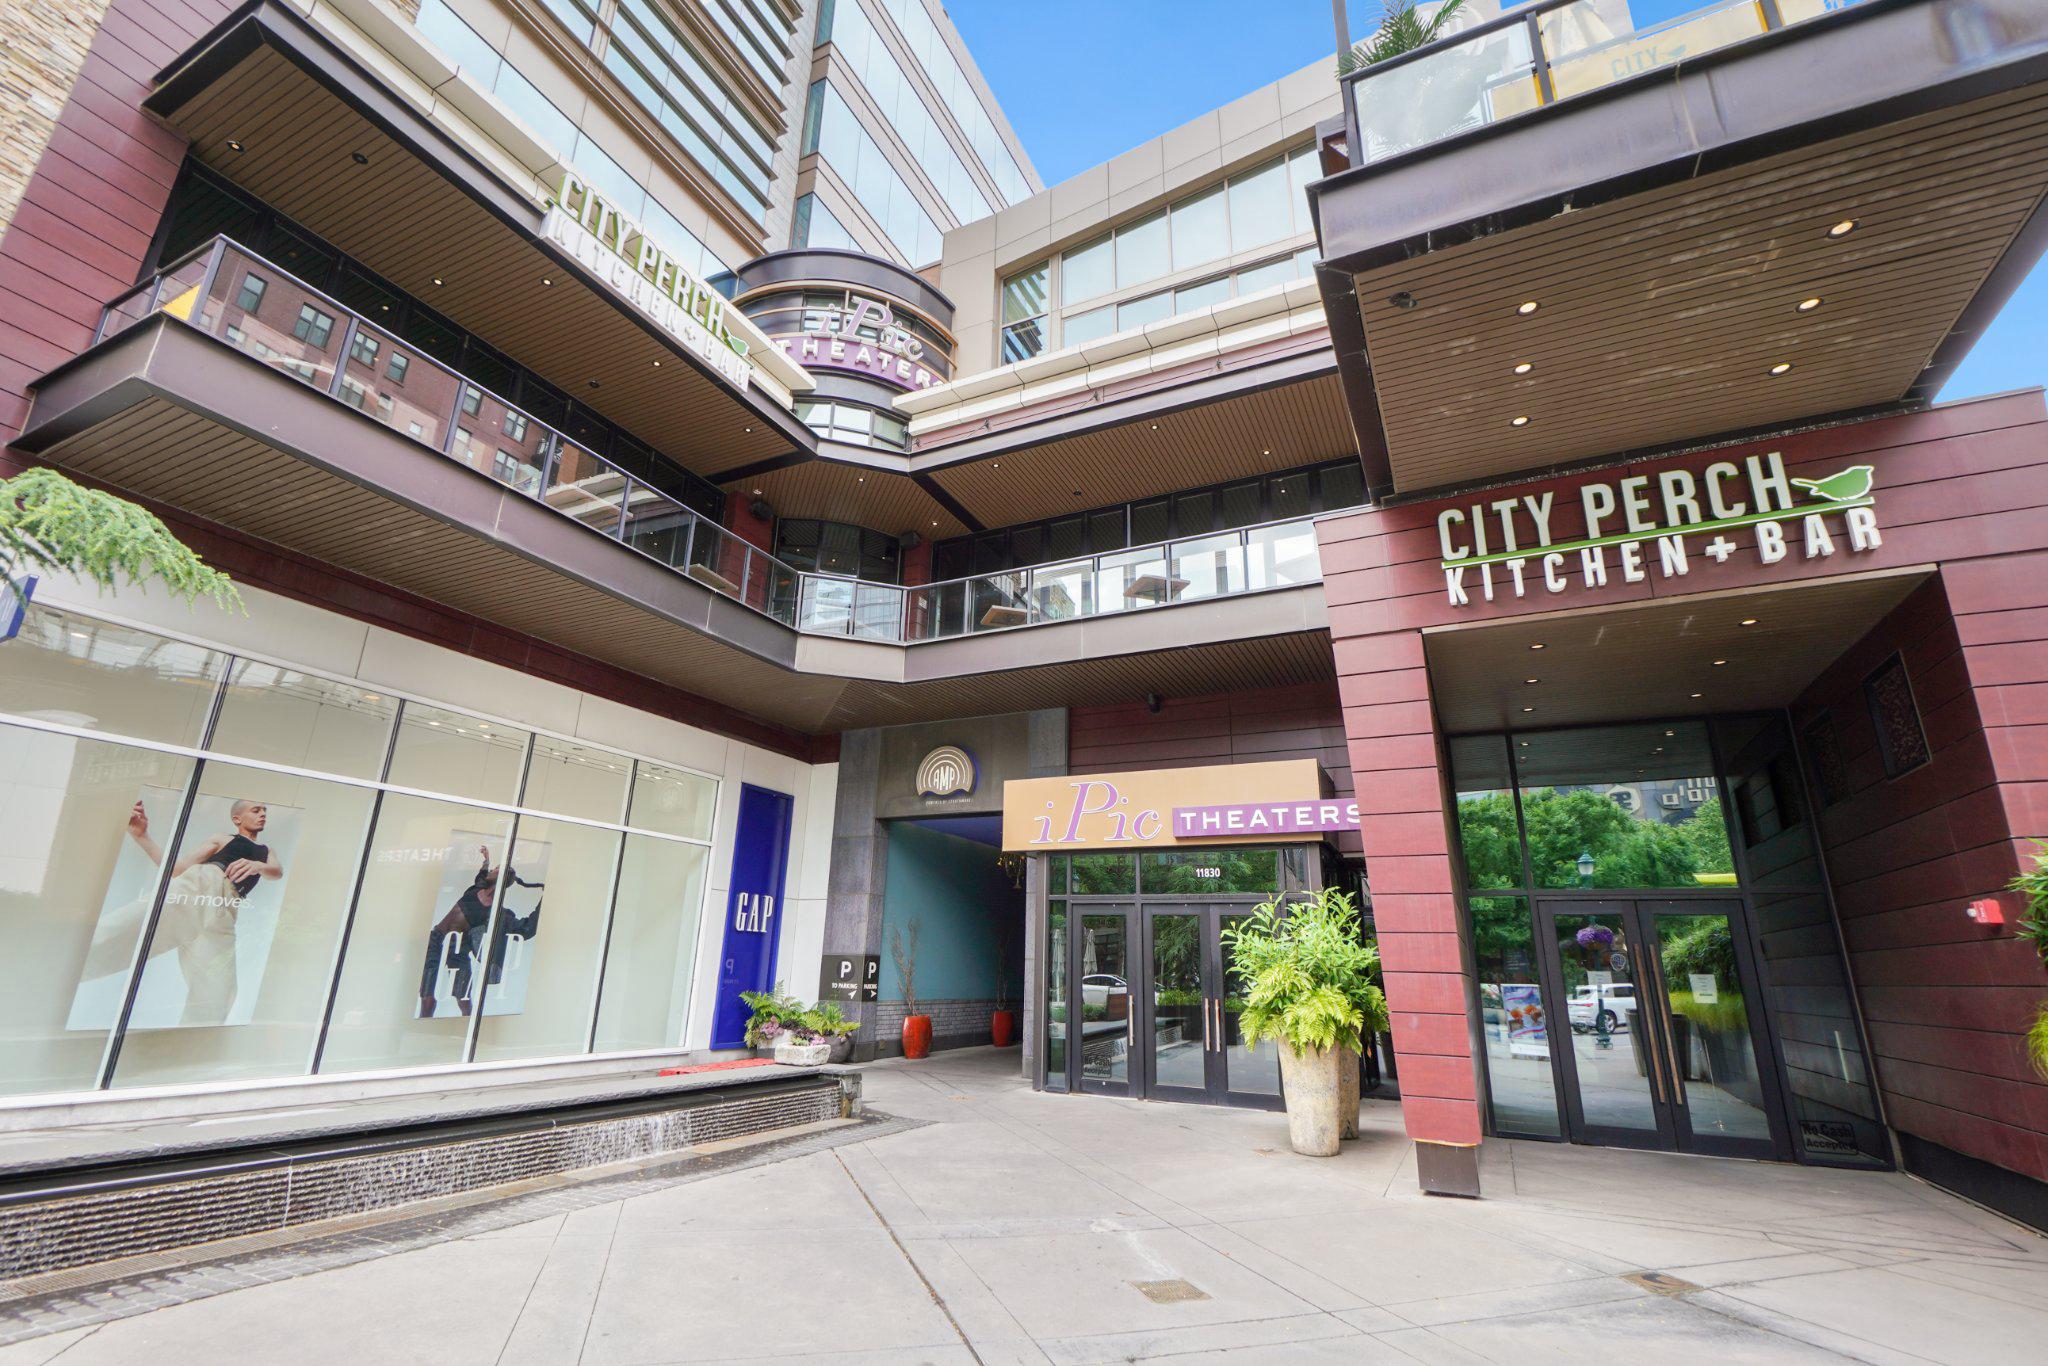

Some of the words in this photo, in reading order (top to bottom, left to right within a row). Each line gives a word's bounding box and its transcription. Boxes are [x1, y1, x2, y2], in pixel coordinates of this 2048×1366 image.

[557, 172, 633, 257] CITY
[634, 234, 725, 335] PERCH
[554, 214, 681, 332] KITCHEN
[703, 334, 748, 386] BAR
[811, 295, 924, 362] iPic
[771, 338, 943, 390] THEATER
[1438, 491, 1554, 562] CITY
[1581, 452, 1794, 539] PERCH
[1445, 535, 1689, 606] KITCHEN
[1755, 507, 1883, 564] BAR
[934, 765, 955, 791] AMP
[1030, 781, 1163, 844] iPic
[1180, 805, 1360, 832] THEATERS
[1196, 868, 1220, 879] 11830
[138, 888, 188, 905] Len
[193, 893, 255, 909] moves.
[735, 892, 774, 933] GAP
[840, 961, 852, 979] P
[868, 961, 877, 979] P
